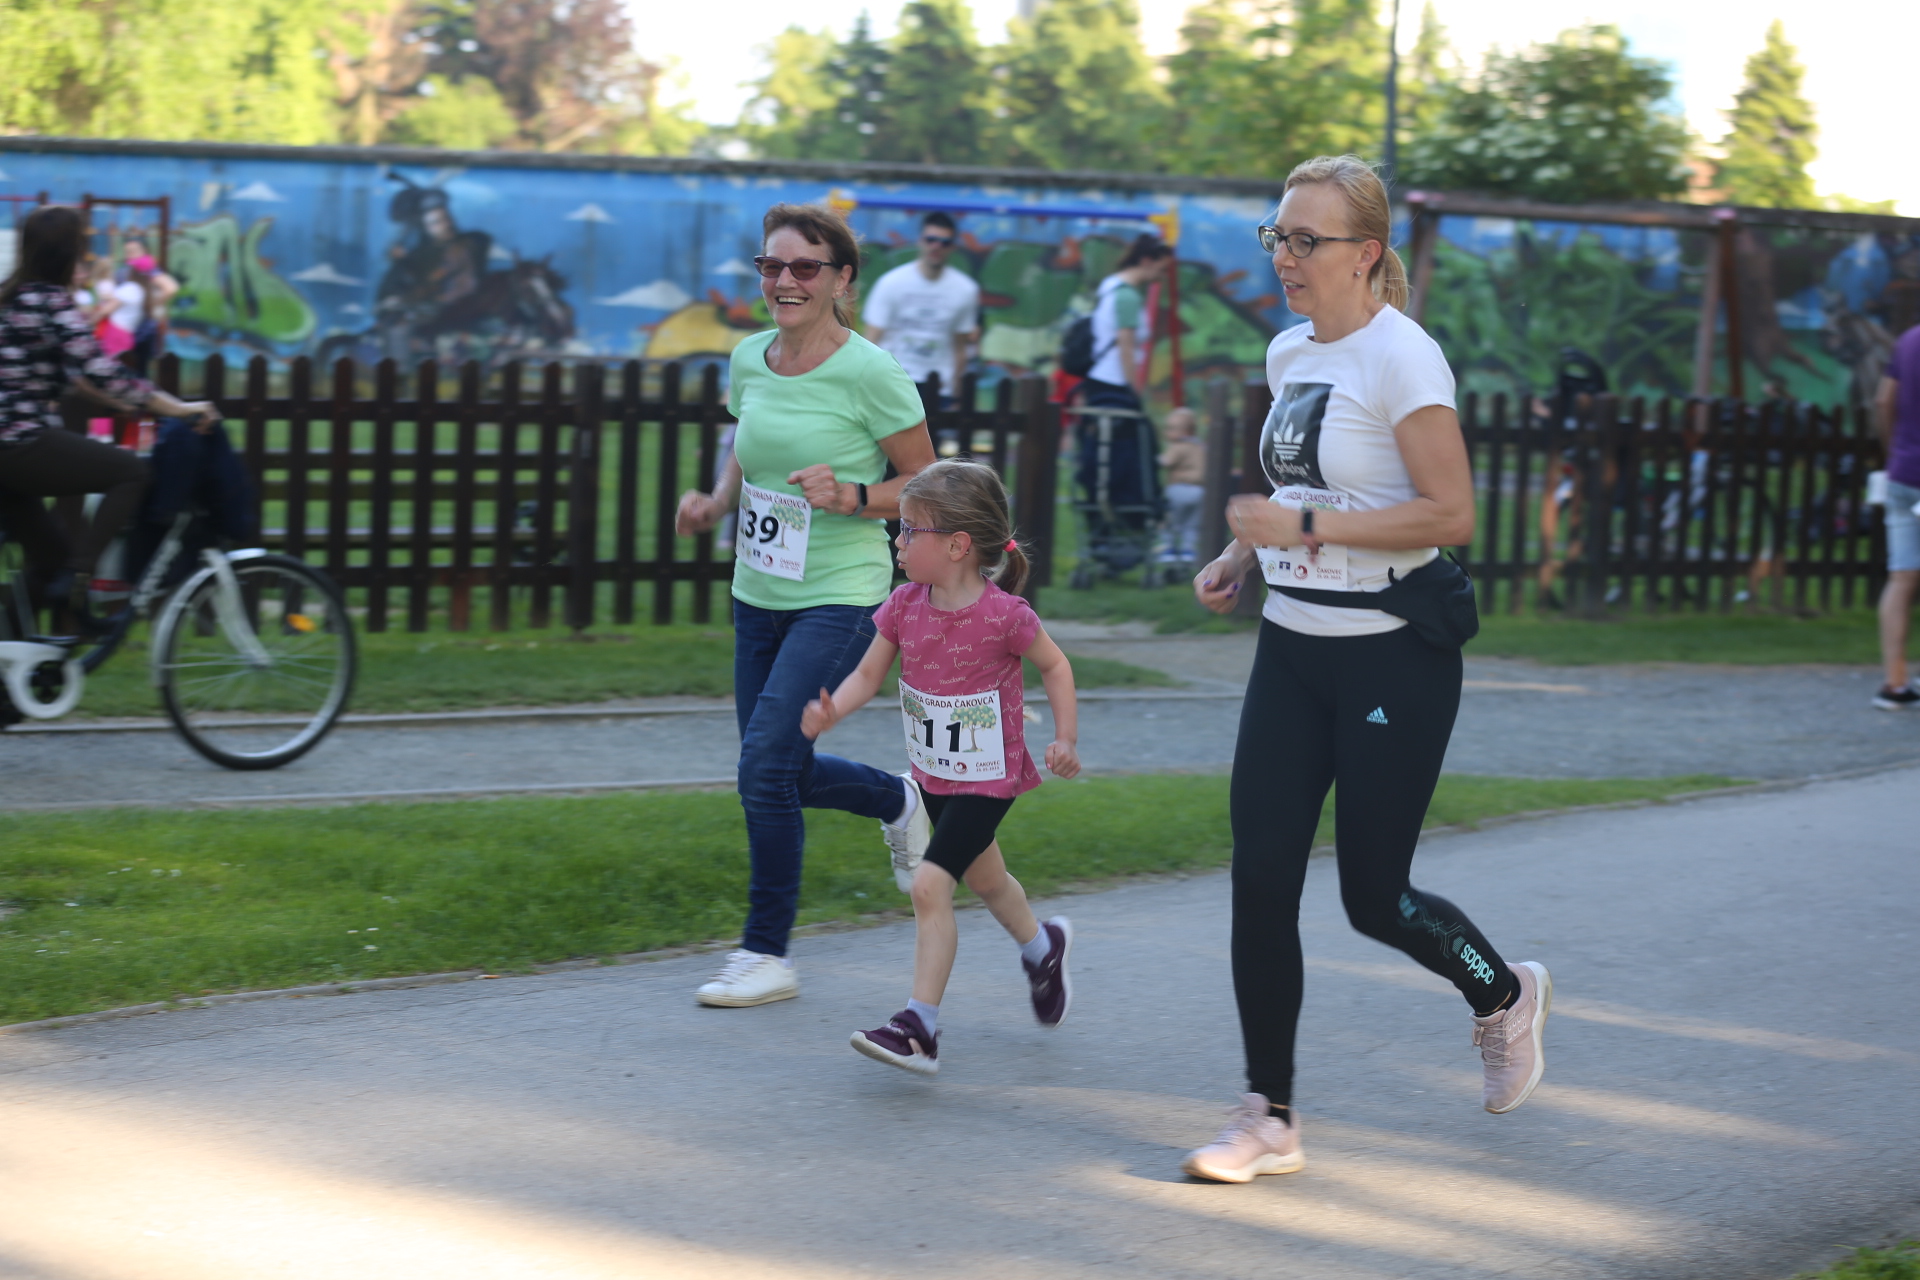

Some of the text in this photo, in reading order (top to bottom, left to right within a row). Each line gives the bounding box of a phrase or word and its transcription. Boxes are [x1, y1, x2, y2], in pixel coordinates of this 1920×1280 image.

[774, 494, 807, 510] ČAKOVCA
[1303, 490, 1342, 505] ČAKOVCA
[745, 510, 779, 544] 39
[925, 698, 952, 708] GRADA
[954, 695, 994, 709] ČAKOVCA
[922, 719, 961, 753] 11
[975, 760, 1000, 768] ČAKOVEC
[1460, 943, 1495, 985] adidas
